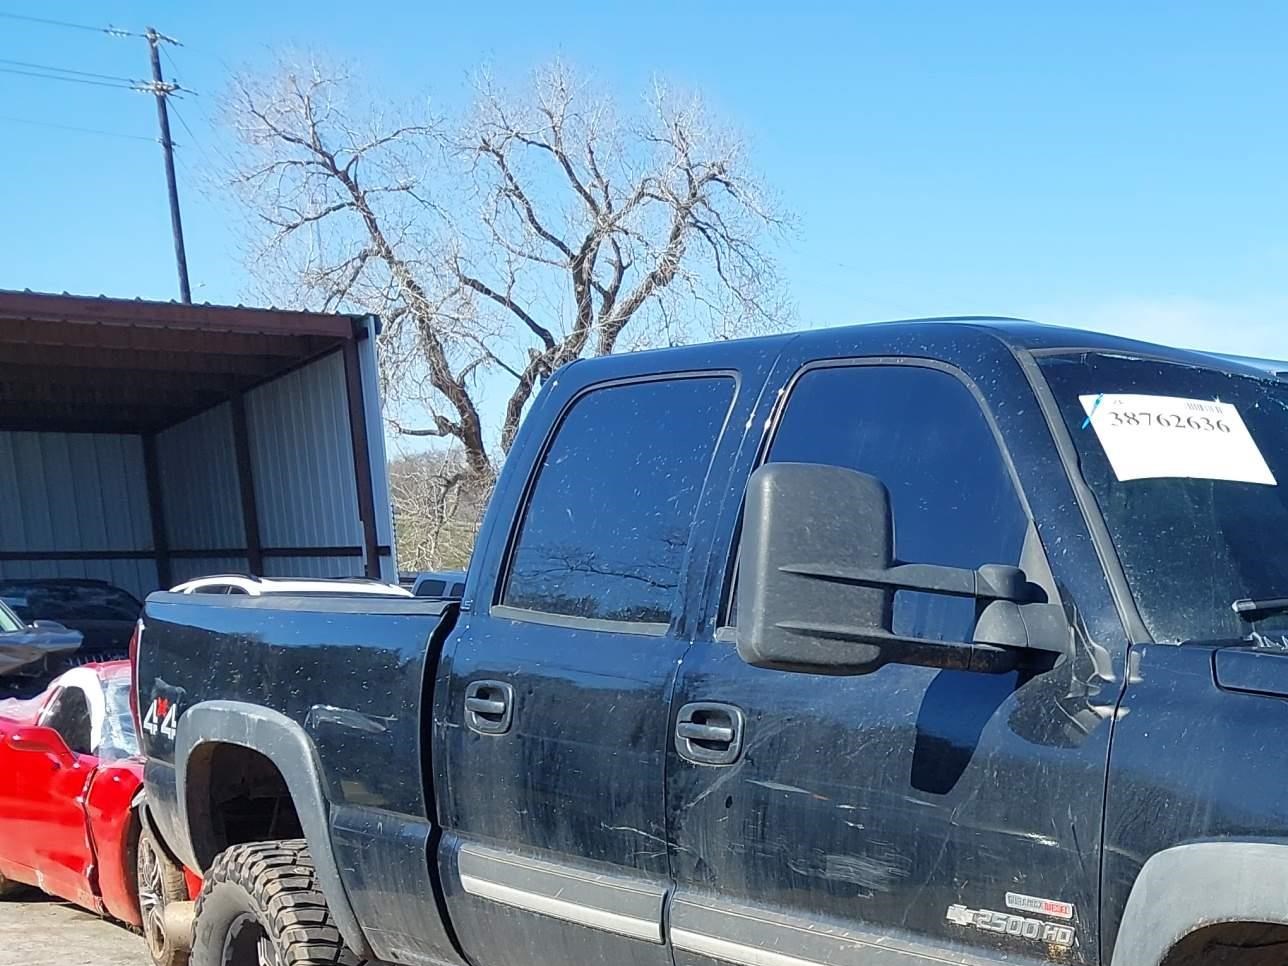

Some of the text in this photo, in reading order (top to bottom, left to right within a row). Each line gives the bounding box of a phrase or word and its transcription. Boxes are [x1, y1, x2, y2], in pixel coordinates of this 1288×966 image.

[1109, 411, 1231, 433] 38762636
[976, 909, 1076, 947] 2500 HD
